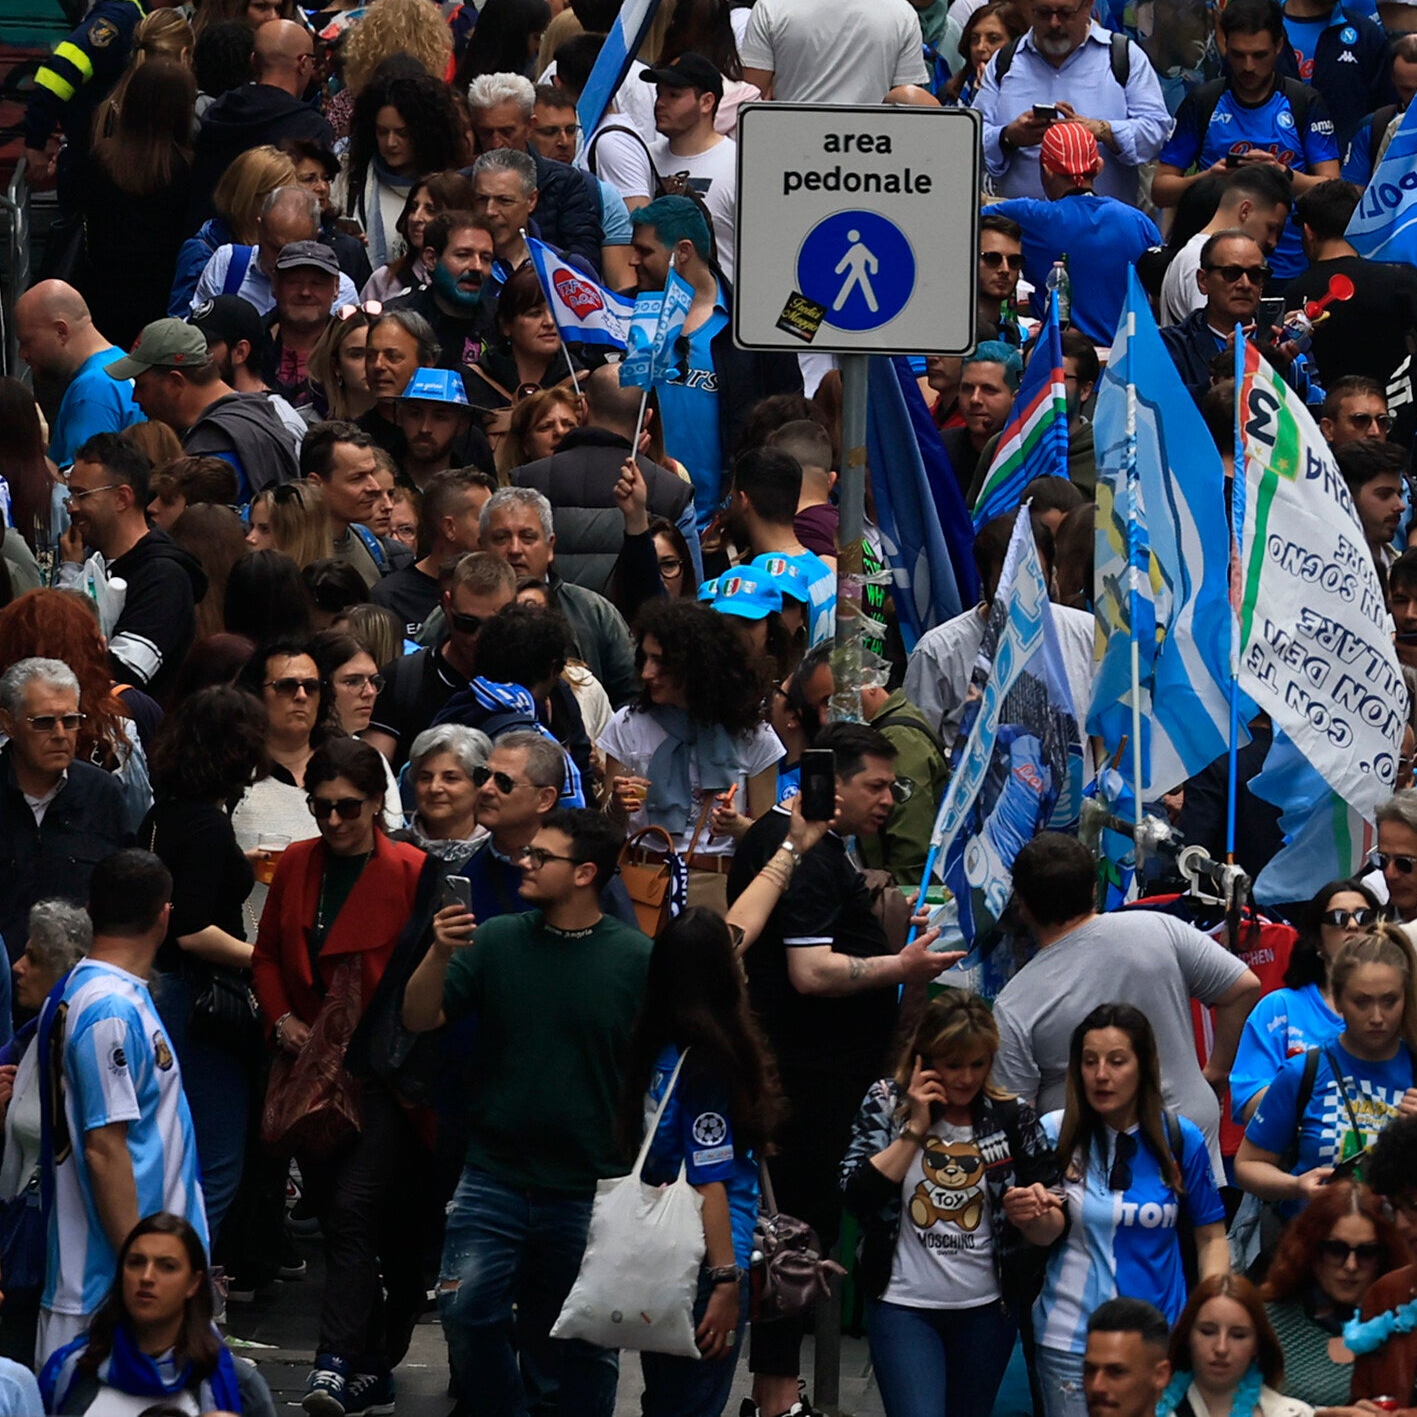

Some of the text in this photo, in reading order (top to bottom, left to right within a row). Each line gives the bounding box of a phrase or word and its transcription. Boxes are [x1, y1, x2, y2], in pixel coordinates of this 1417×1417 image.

[822, 132, 893, 154] area
[782, 167, 932, 194] pedonale
[1245, 387, 1283, 448] 3
[1266, 532, 1358, 606] SOGNO
[1245, 642, 1280, 693] TE
[1261, 615, 1404, 743] NON DEVI
[1284, 683, 1355, 749] CON
[935, 1193, 966, 1208] TOY
